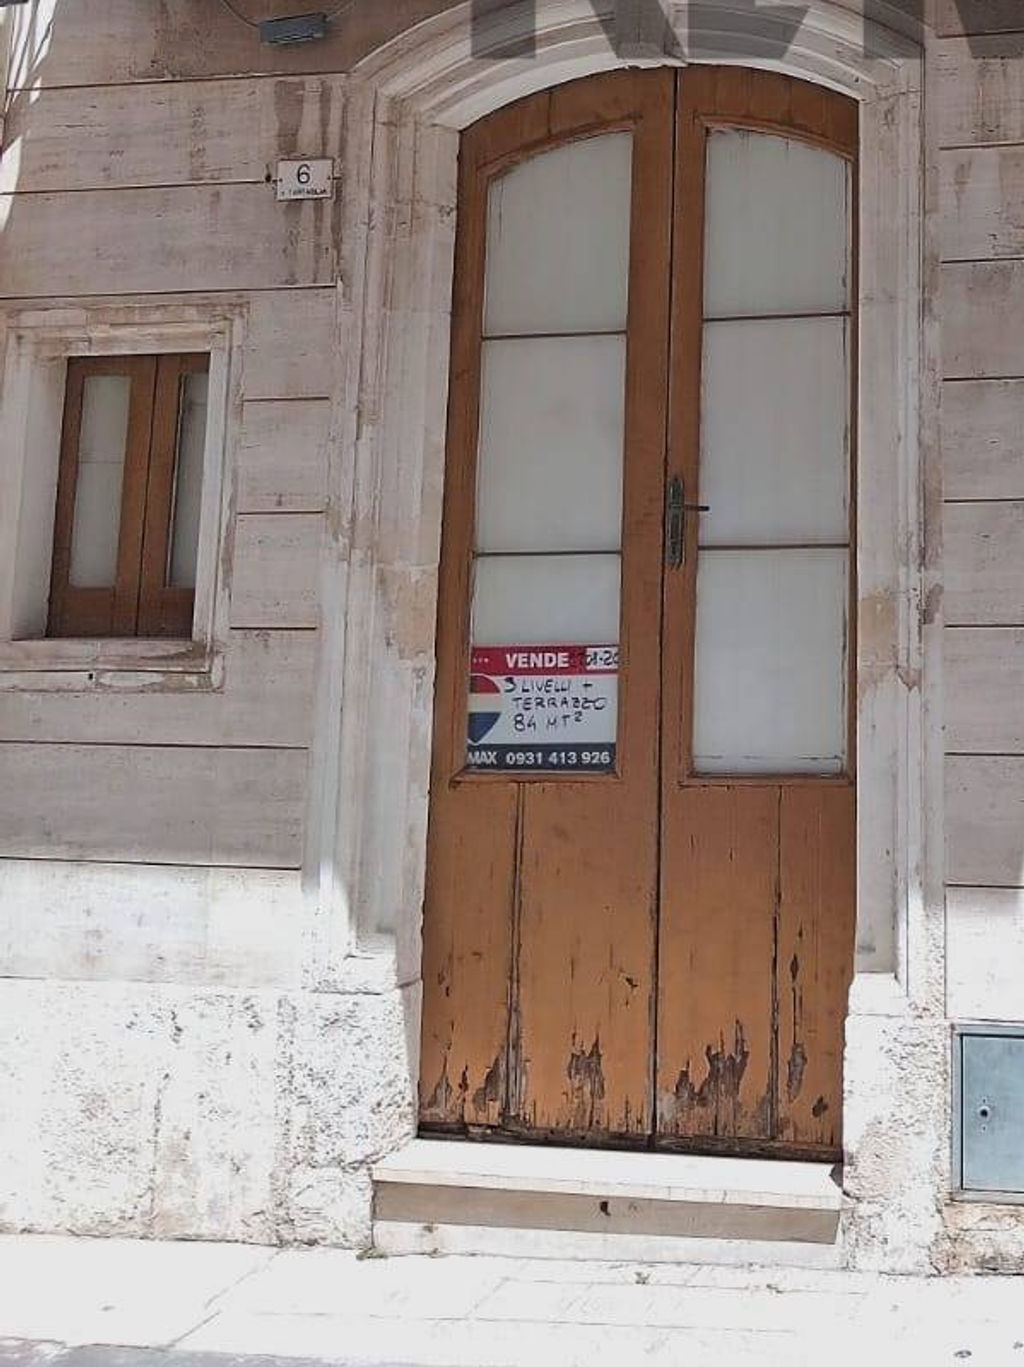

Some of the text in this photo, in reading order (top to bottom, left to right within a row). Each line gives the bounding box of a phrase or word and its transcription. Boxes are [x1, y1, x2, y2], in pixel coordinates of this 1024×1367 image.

[297, 164, 310, 184] 6
[505, 653, 570, 668] VENDE
[504, 677, 517, 693] 3
[521, 678, 571, 693] LIVELLI
[512, 697, 607, 711] TERRAZZO
[514, 713, 537, 732] 84
[505, 751, 543, 765] 0931
[548, 751, 578, 765] 413
[581, 751, 611, 765] 926
